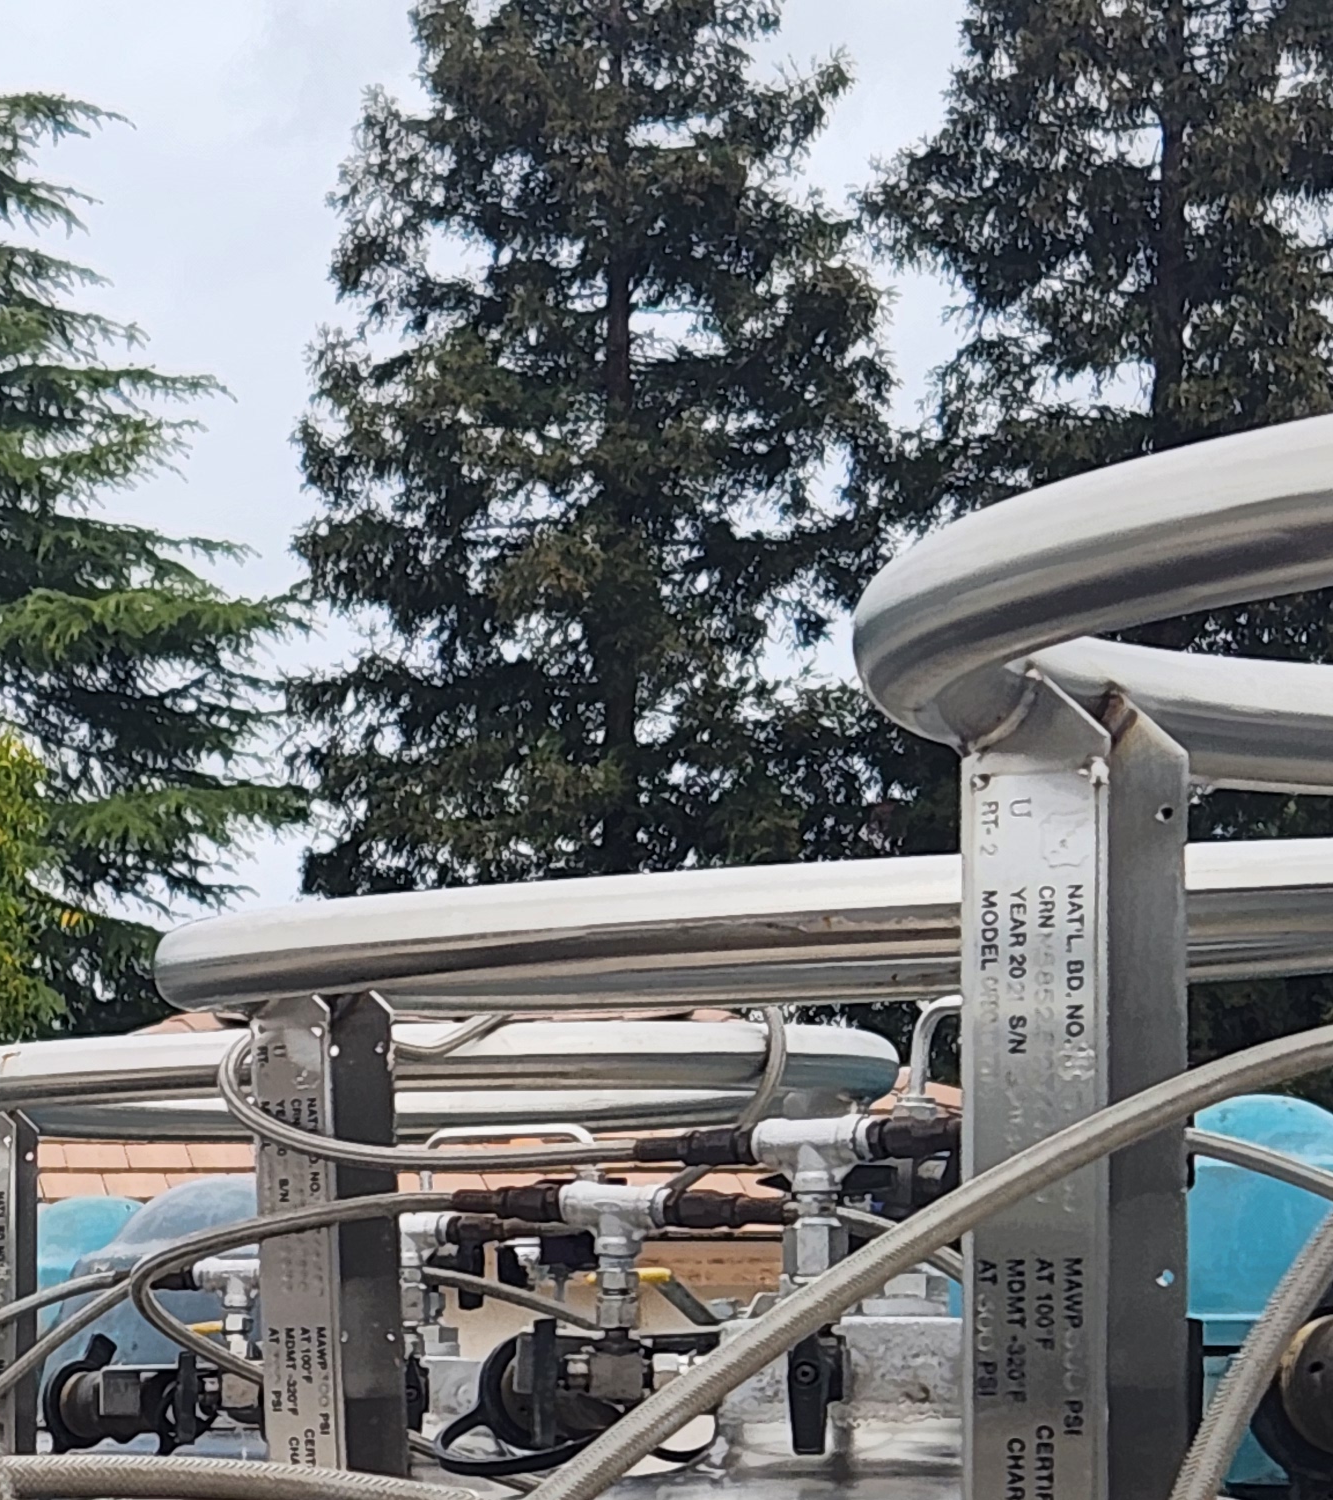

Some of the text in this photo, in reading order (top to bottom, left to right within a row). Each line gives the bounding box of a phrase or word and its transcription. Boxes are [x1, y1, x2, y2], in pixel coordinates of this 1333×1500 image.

[1009, 887, 1028, 949] YEAR
[1038, 885, 1056, 929] CRN
[979, 890, 1000, 971] MODEL
[1007, 1014, 1028, 1055] S/N
[1063, 1003, 1085, 1044] NO.
[977, 1258, 998, 1287] AT
[1035, 1257, 1055, 1286] AT
[1006, 1258, 1027, 1330] MDMT
[1062, 1256, 1084, 1329] MAWP
[977, 1360, 998, 1397] PSI
[1062, 1400, 1084, 1436] PSI
